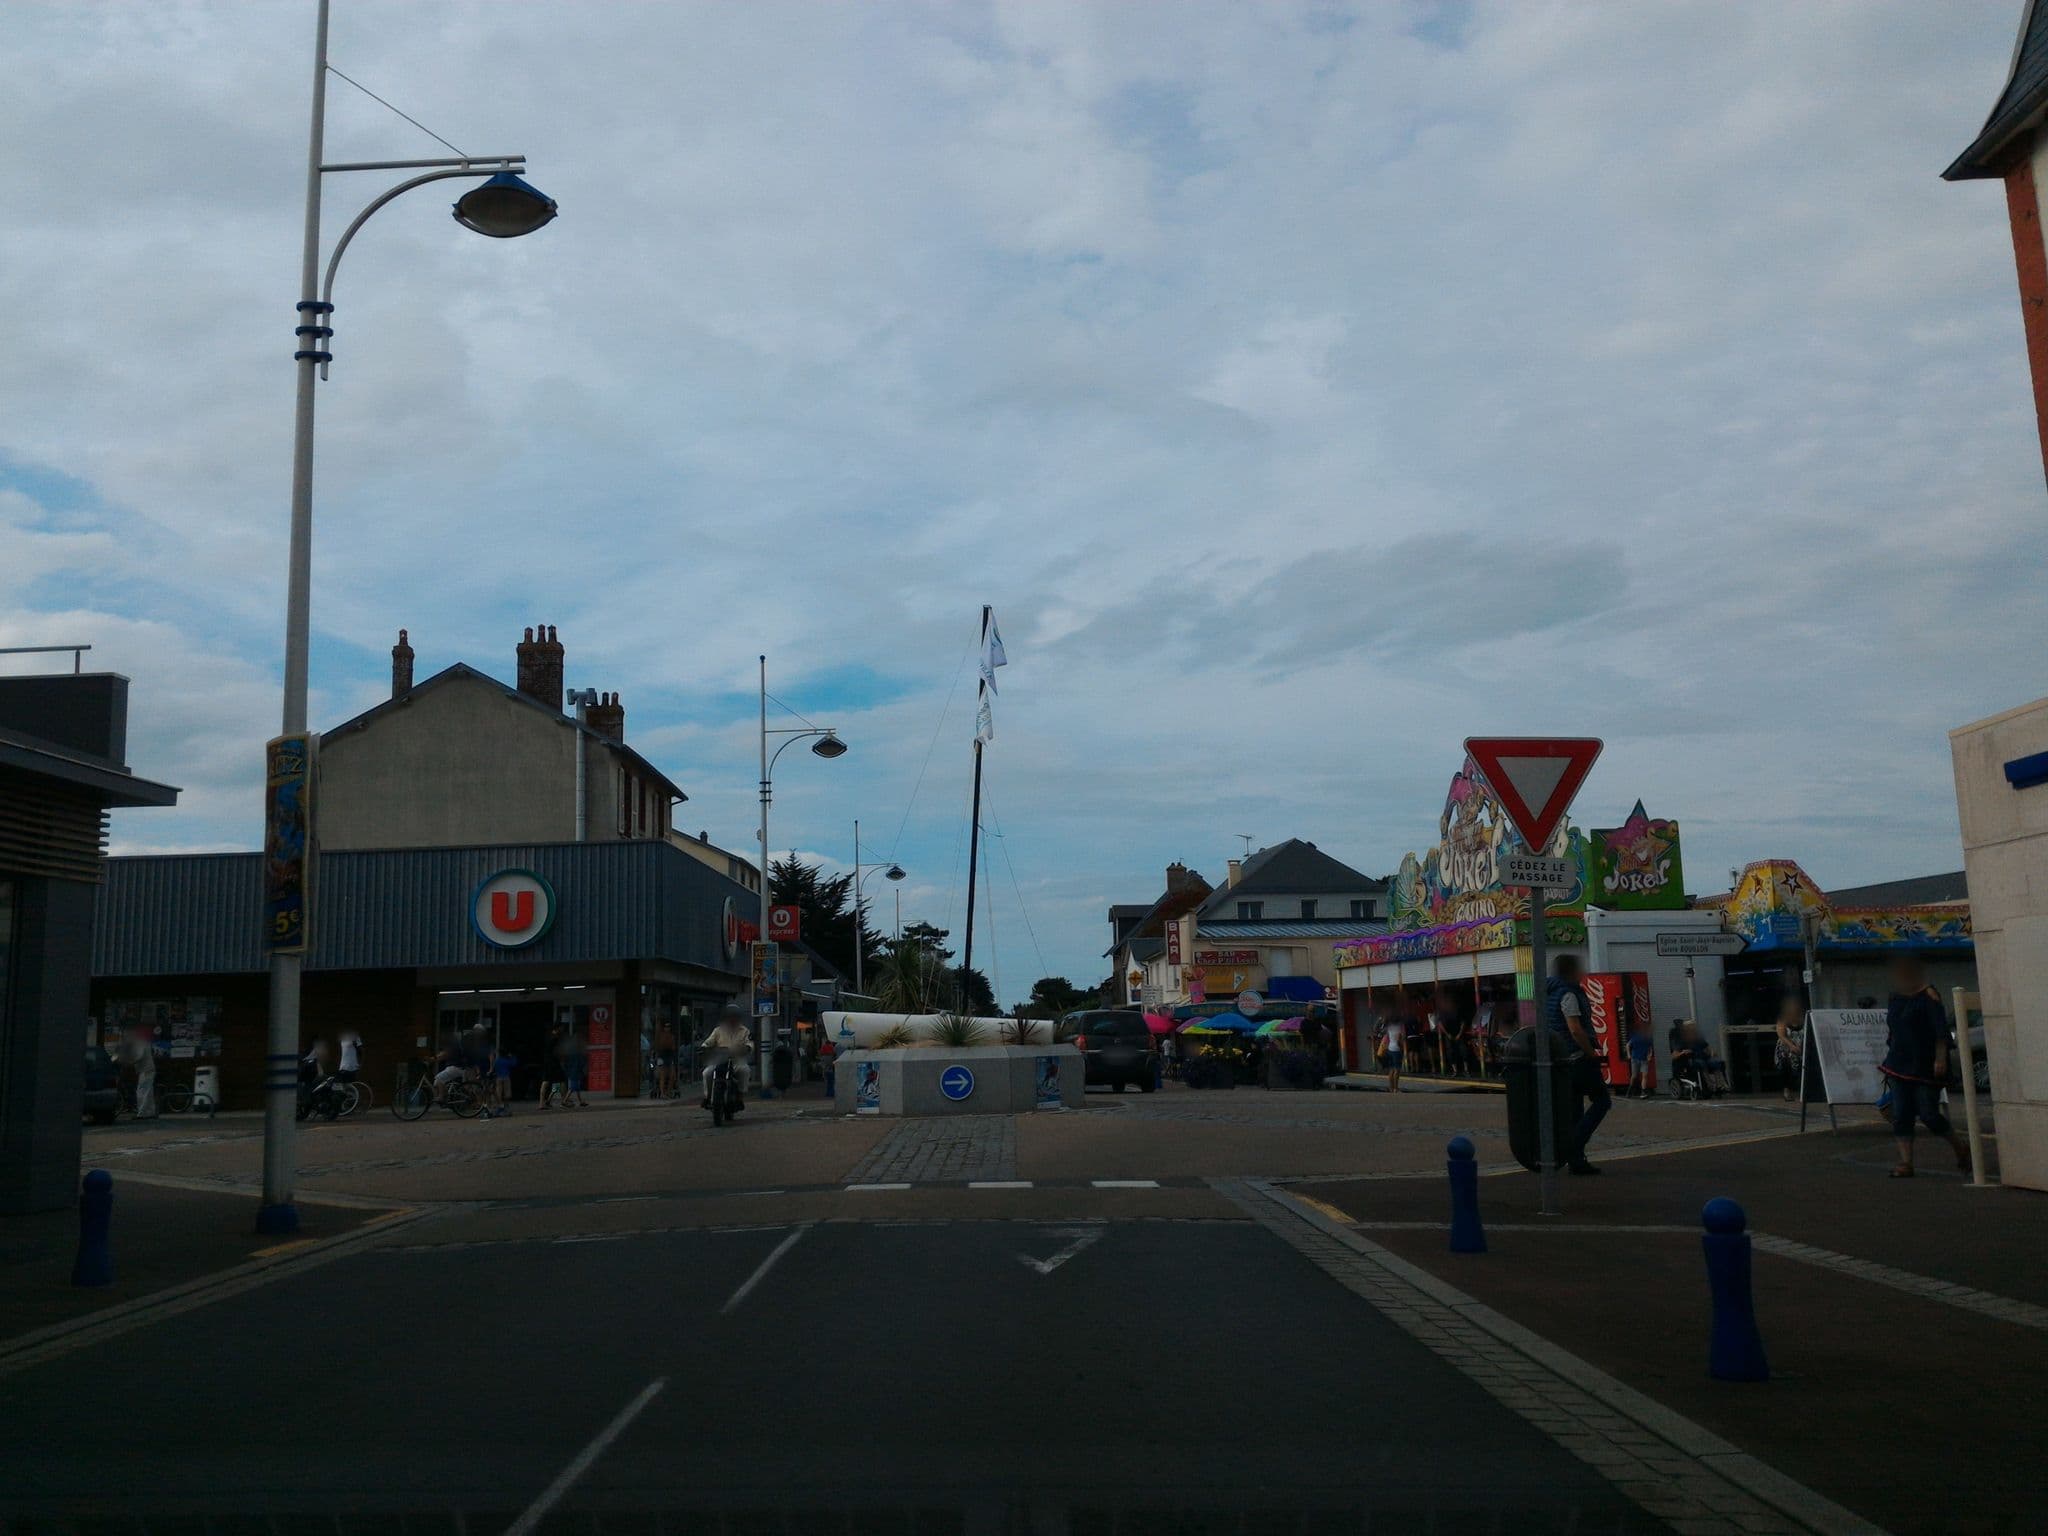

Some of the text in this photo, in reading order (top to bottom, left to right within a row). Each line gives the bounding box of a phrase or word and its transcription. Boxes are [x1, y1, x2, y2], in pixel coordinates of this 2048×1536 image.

[1510, 860, 1567, 871] CÉDEZ LE
[1512, 872, 1564, 883] PASSAGE
[491, 891, 535, 932] U
[1454, 898, 1497, 922] CASINO
[1168, 922, 1178, 954] BAR
